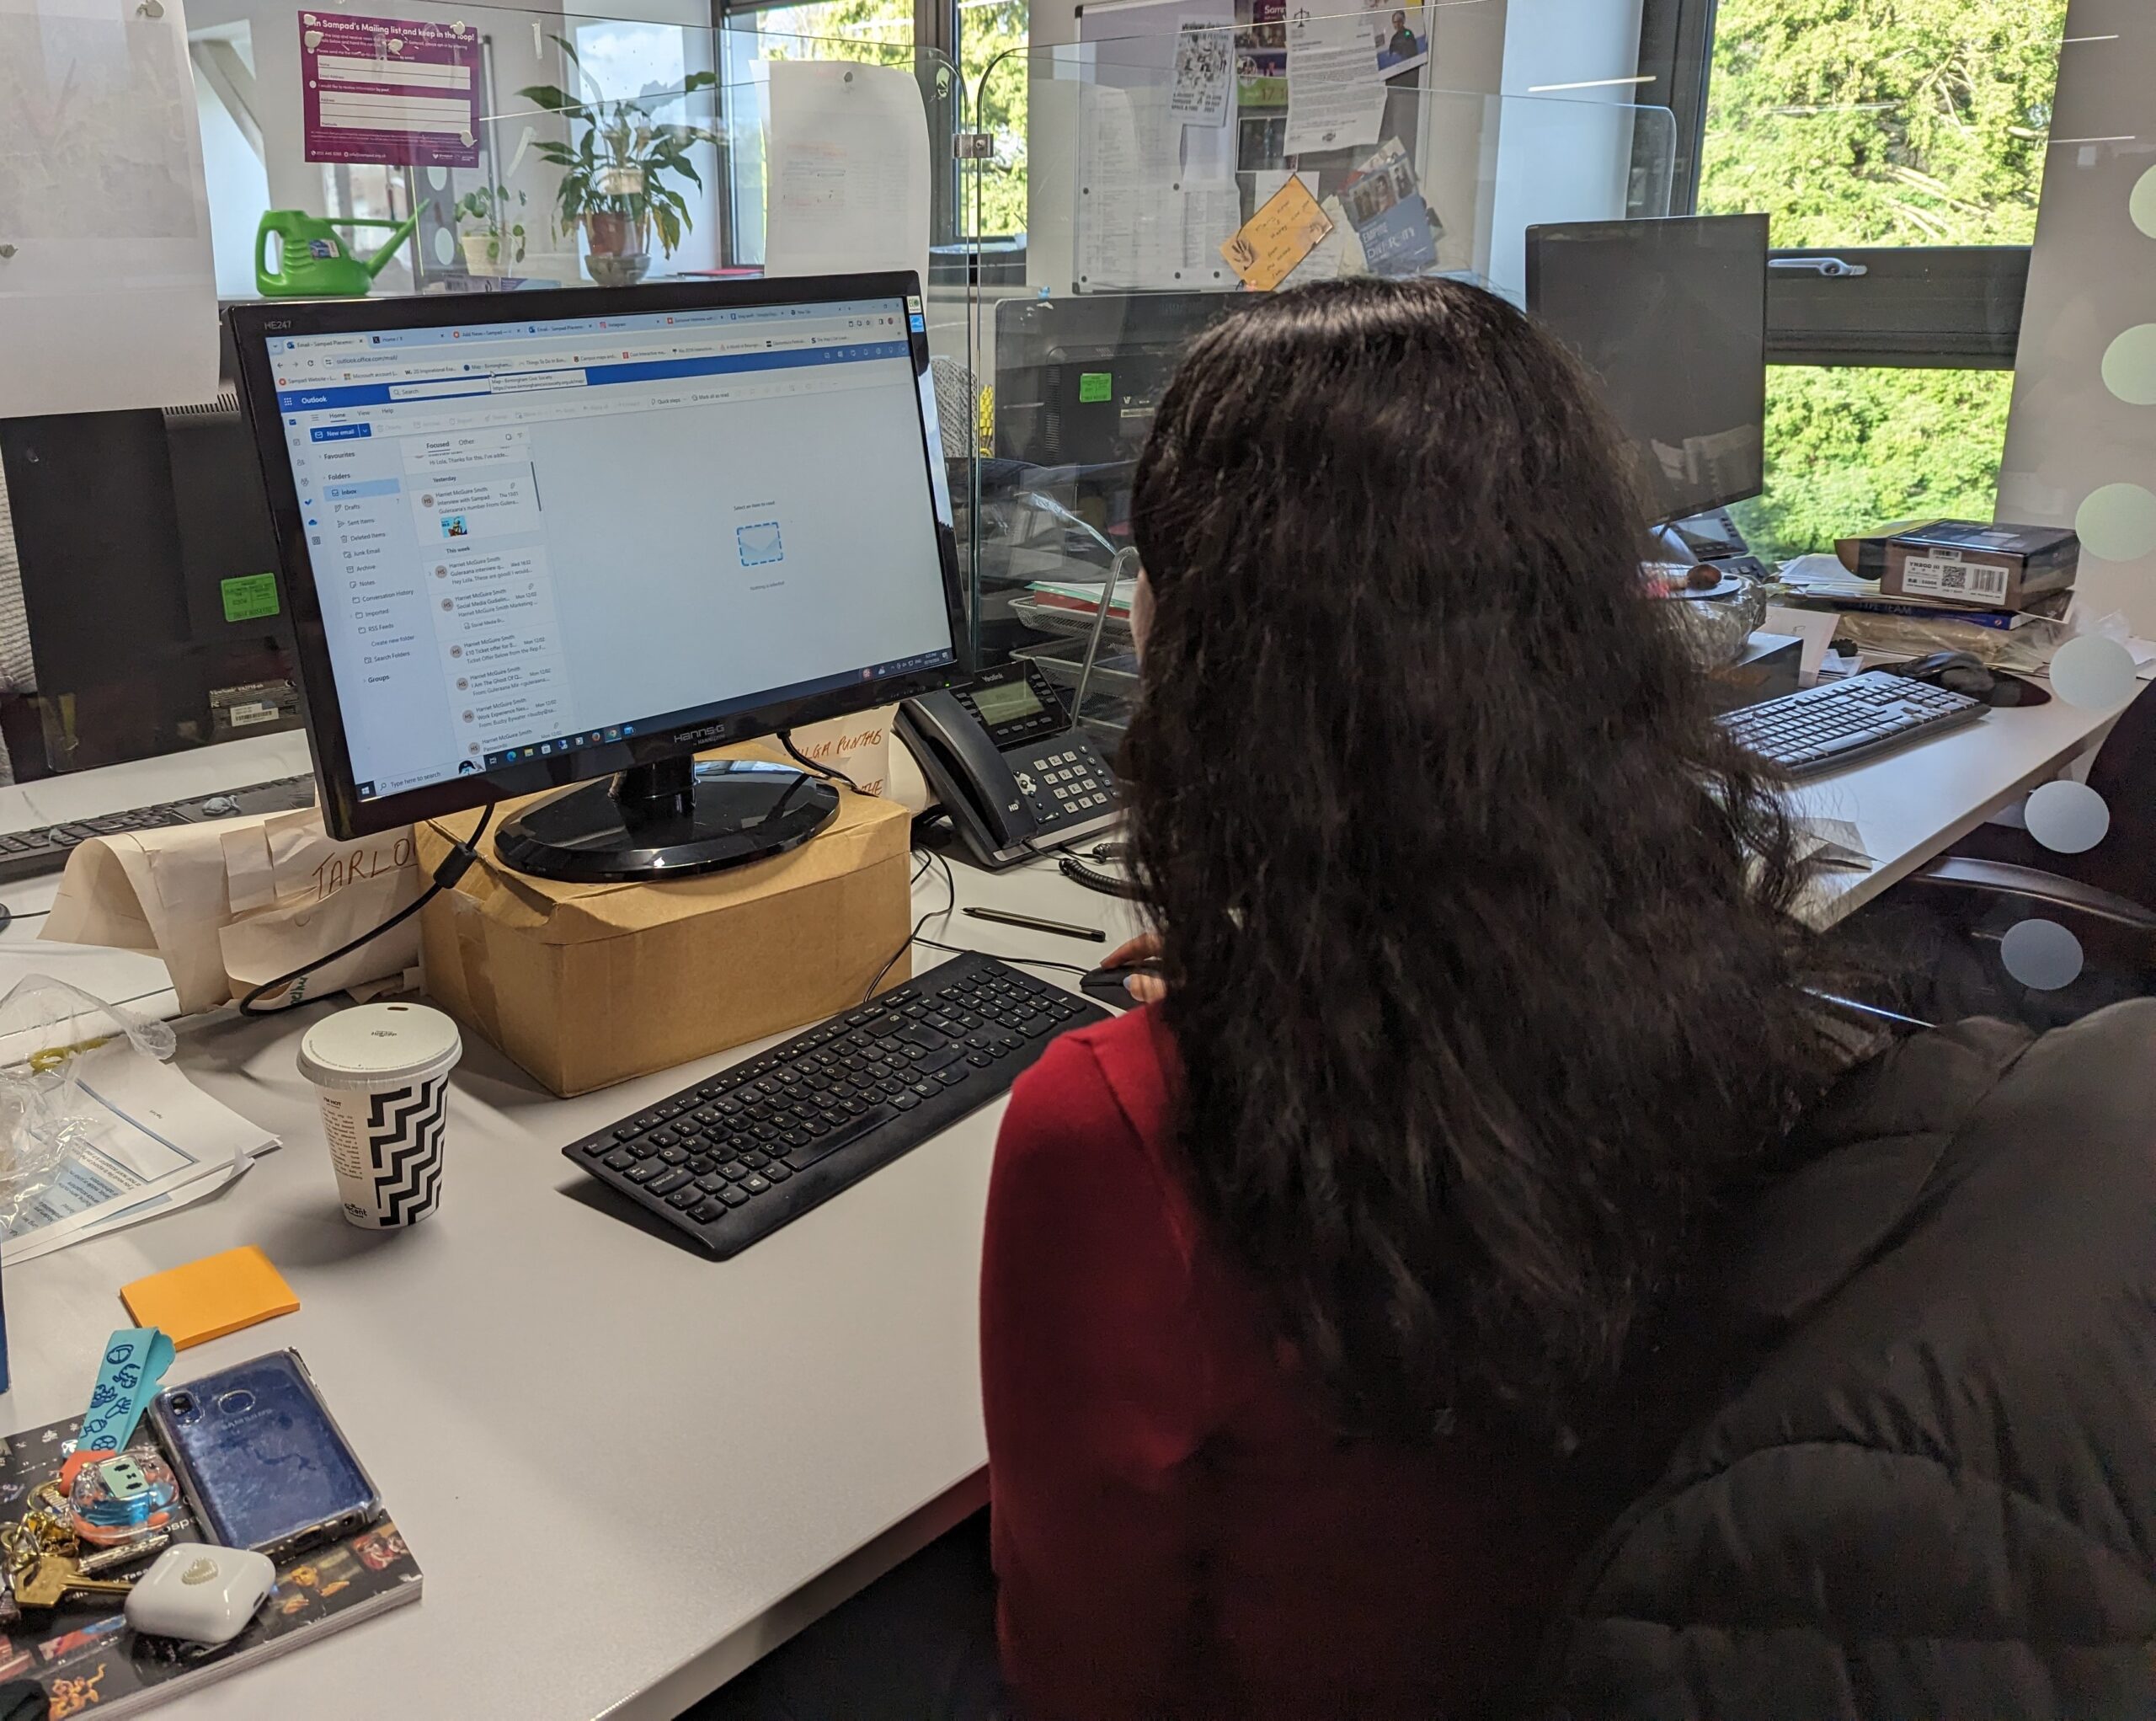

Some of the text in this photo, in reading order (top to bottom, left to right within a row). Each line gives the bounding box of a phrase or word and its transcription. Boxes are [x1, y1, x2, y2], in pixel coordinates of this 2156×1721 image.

[323, 19, 360, 31] Sampad's
[361, 24, 389, 35] Mailing
[418, 29, 435, 39] keep
[301, 395, 328, 404] Outlook
[382, 407, 393, 415] Help
[426, 441, 450, 449] Focused
[323, 451, 355, 460] Favourites
[328, 472, 350, 480] Folders
[433, 475, 456, 484] Yesterday
[471, 494, 490, 503] Sampad
[362, 589, 414, 602] Conversation History
[365, 608, 389, 617] Imported
[371, 639, 388, 647] Create
[373, 650, 410, 662] Search Folders
[367, 675, 390, 684] Groups
[981, 673, 1004, 683] Yealink
[491, 708, 515, 718] Experience
[391, 779, 404, 789] Type
[404, 777, 417, 785] here
[424, 772, 440, 781] search
[312, 838, 418, 901] TARLO
